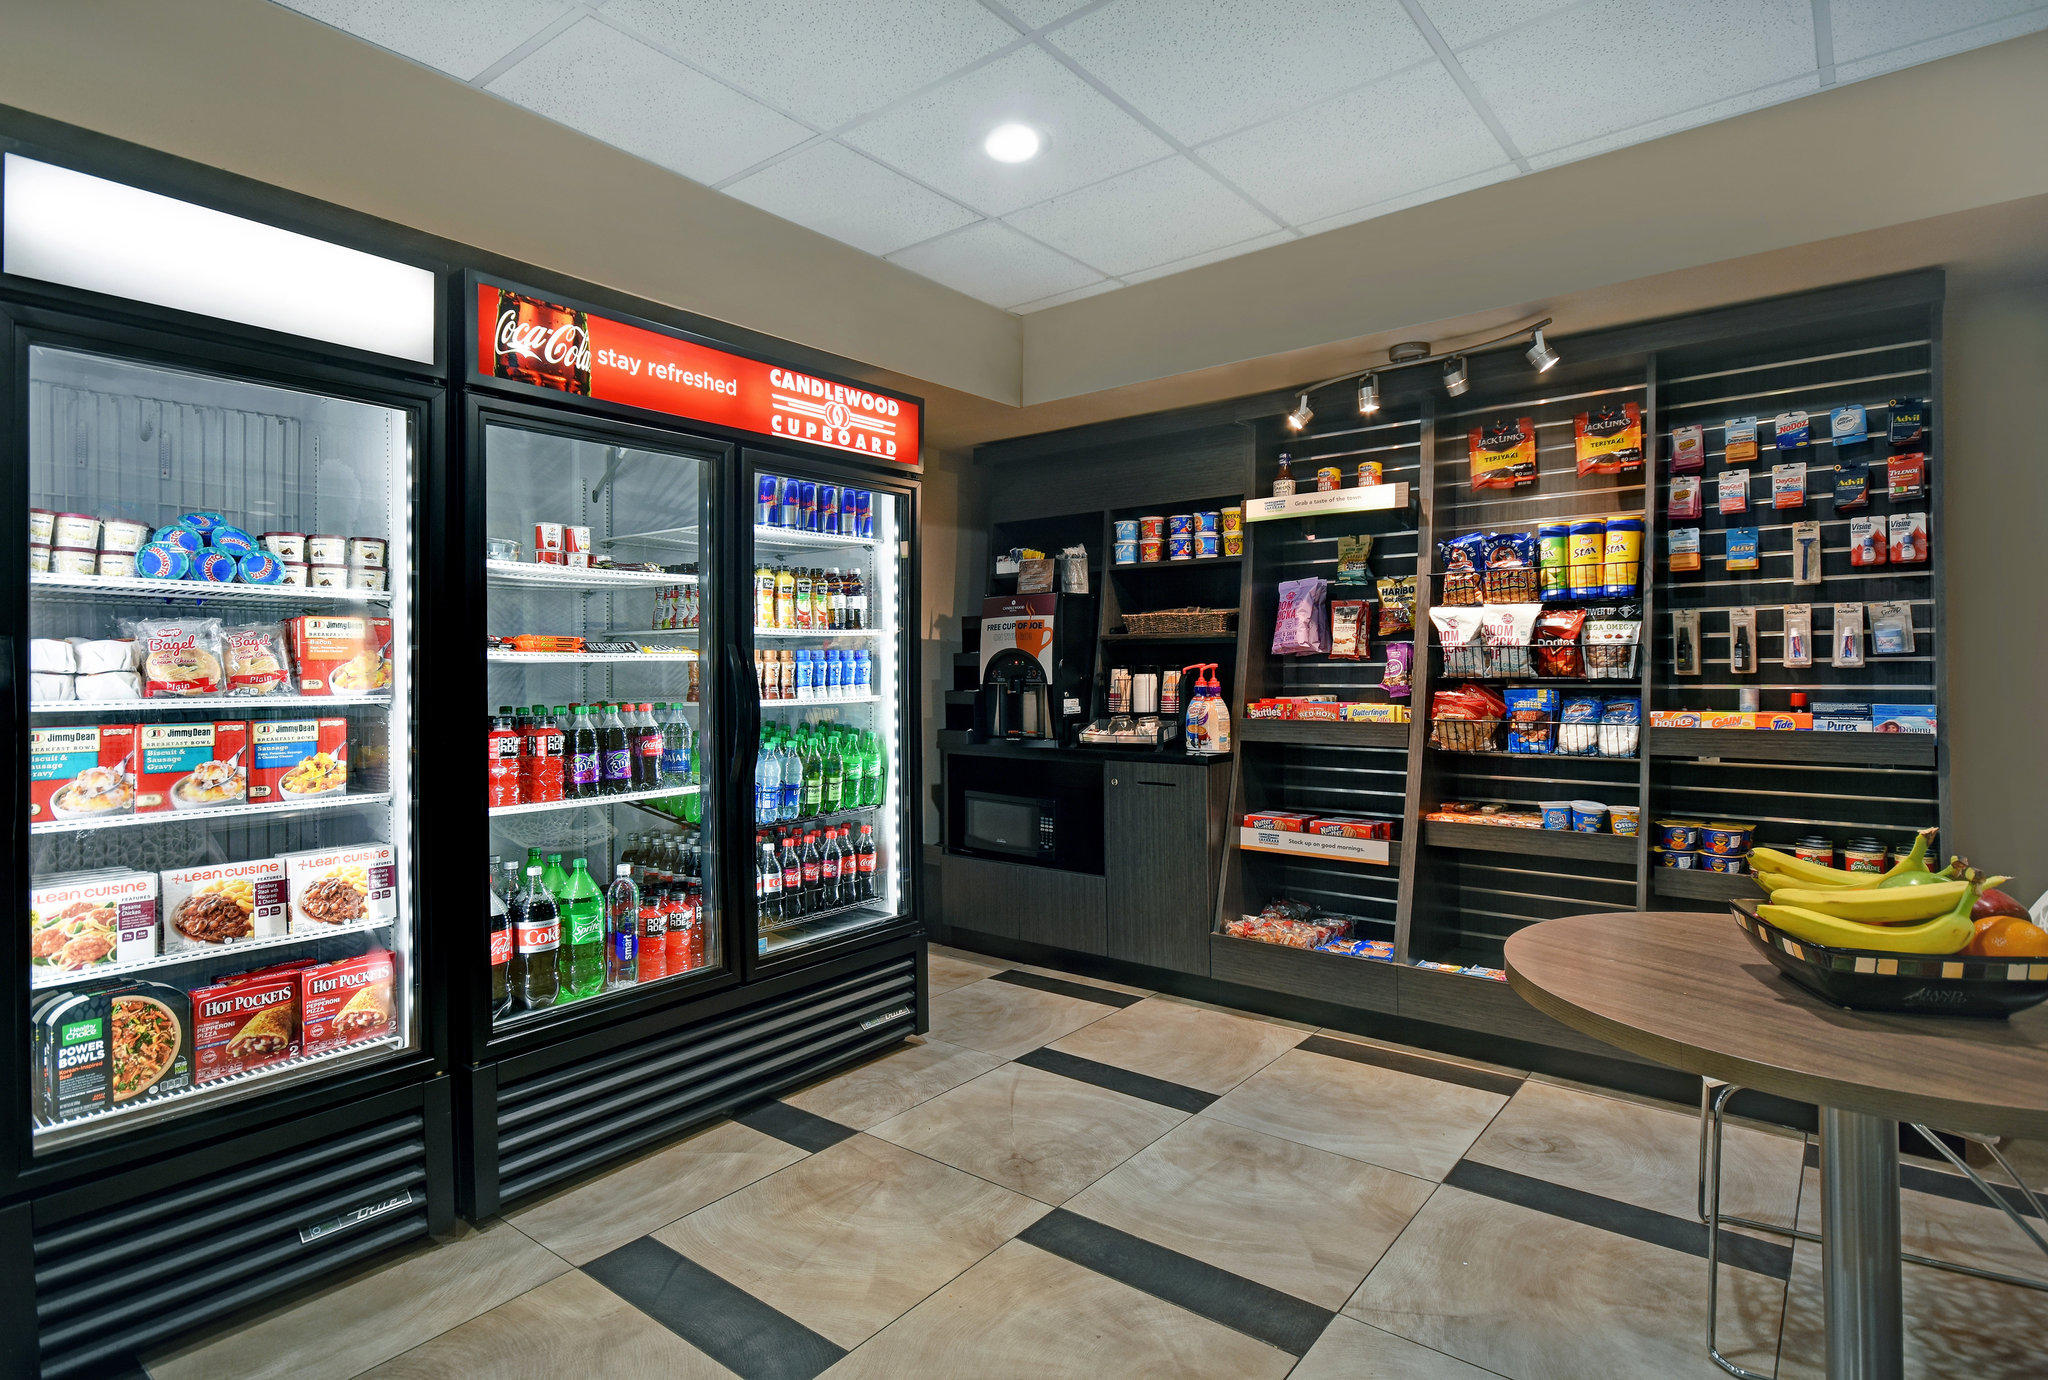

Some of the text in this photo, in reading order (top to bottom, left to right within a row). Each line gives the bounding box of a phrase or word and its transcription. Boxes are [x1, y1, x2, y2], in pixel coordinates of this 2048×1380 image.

[495, 308, 592, 372] Coca-Cola
[597, 347, 738, 397] stay refreshed
[769, 368, 900, 417] CANDLEWOOD
[1894, 415, 1920, 423] Advil
[1583, 422, 1605, 434] JACK
[1780, 419, 1808, 433] NoDoz
[771, 415, 898, 457] CUPBOARD
[1477, 436, 1499, 448] JACK
[1590, 437, 1624, 448] TERIYAKI
[1484, 451, 1519, 463] TERIYAKI
[1776, 476, 1802, 484] DayQuil
[1838, 477, 1865, 487] Advil
[1720, 483, 1744, 491] DayQuil
[1294, 499, 1309, 507] Grab
[1852, 522, 1872, 531] Visine
[1890, 519, 1912, 529] Visine
[1381, 585, 1415, 596] HARIBO
[326, 621, 347, 630] Jimmy
[986, 621, 1043, 632] FREE CUP OF JOE
[147, 634, 197, 657] Bagel
[231, 633, 273, 652] Bagel
[587, 641, 634, 652] HERSHEY'S
[250, 674, 273, 684] Plain
[166, 683, 191, 691] Plain
[1250, 708, 1282, 719] Skittles
[1352, 708, 1389, 717] Butterfinger
[1655, 717, 1694, 728] bounce
[1712, 714, 1743, 729] GAIN
[1772, 719, 1794, 731] Tide
[1827, 720, 1858, 732] Purex
[167, 728, 212, 738] Jimmy Dean
[275, 724, 315, 734] Jimmy Dean
[48, 732, 96, 743] Jimmy Dean
[147, 748, 178, 757] Biscuit
[147, 756, 182, 764] Sausage
[1252, 818, 1273, 827] Nutter
[1319, 825, 1342, 834] Nutter
[1288, 838, 1304, 846] Stock
[1336, 844, 1365, 852] mornings.
[343, 849, 390, 863] cuisine
[184, 862, 280, 883] Lean cuisine
[36, 881, 148, 905] Lean cuisine
[121, 894, 151, 902] FEATURES
[524, 924, 560, 946] Coke
[313, 964, 391, 995] HOT POCKETS
[205, 986, 292, 1018] HOT POCKETS
[305, 997, 341, 1010] PEPPERONI
[305, 1006, 326, 1016] PIZZA
[69, 1023, 97, 1035] Healthy
[196, 1020, 237, 1035] PEPPERONI
[388, 1020, 397, 1031] 2
[65, 1028, 98, 1042] Choice
[196, 1031, 218, 1040] PIZZA
[58, 1040, 105, 1059] POWER
[289, 1045, 300, 1057] 2
[58, 1050, 106, 1070] BOWLS
[59, 1073, 73, 1081] Beef
[347, 1197, 404, 1220] True
